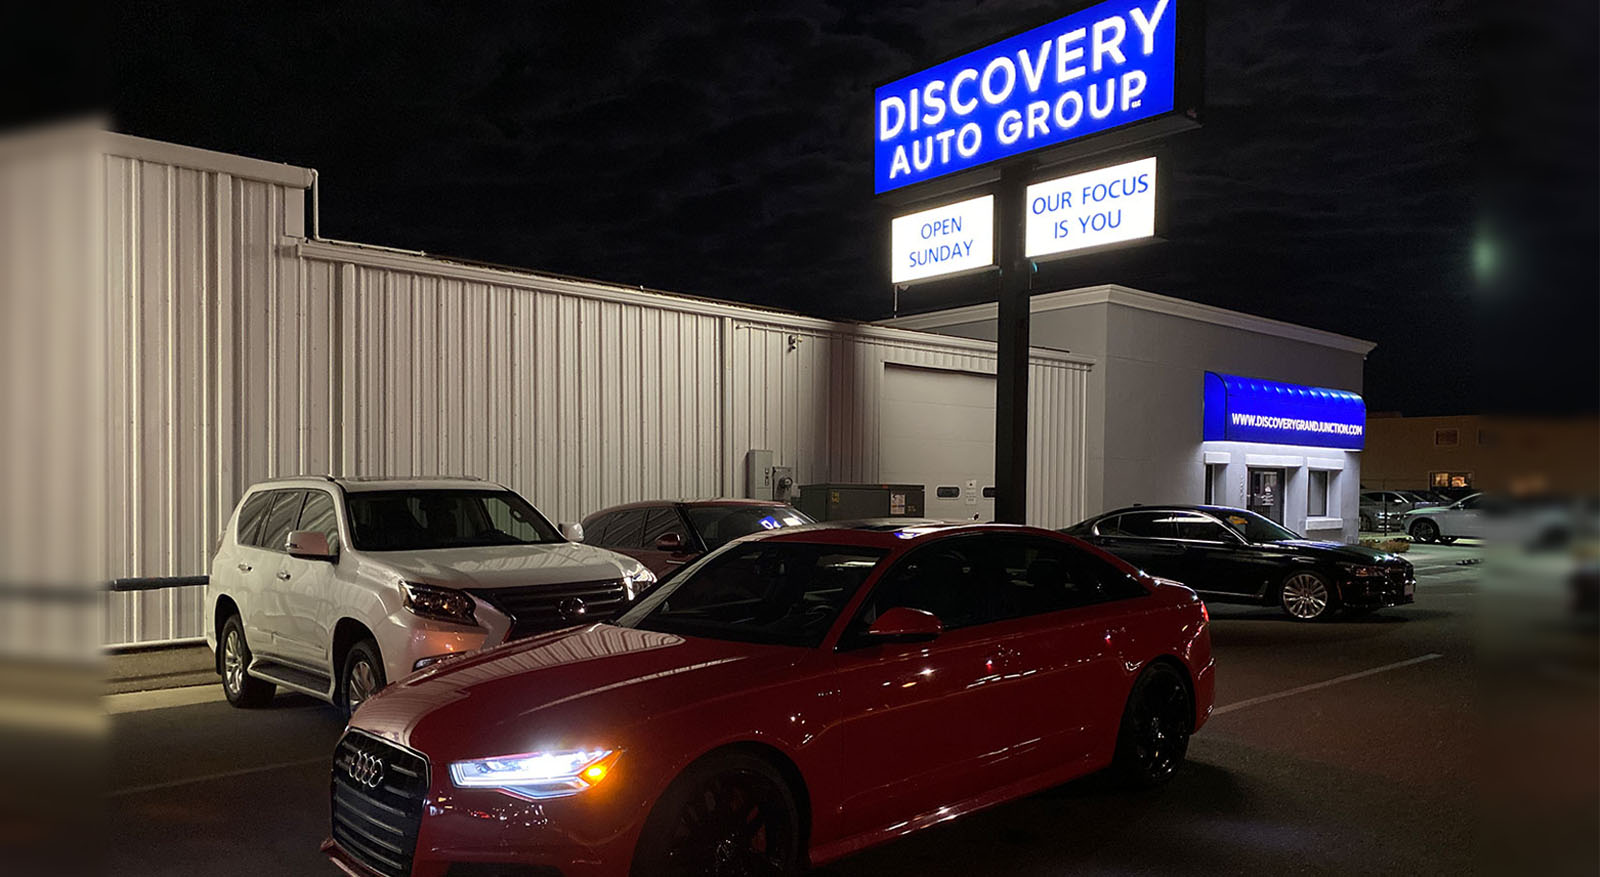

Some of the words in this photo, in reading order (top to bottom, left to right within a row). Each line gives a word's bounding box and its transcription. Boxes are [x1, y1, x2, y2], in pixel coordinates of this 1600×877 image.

[880, 0, 1169, 141] DISCOVERY
[889, 122, 982, 179] AUTO
[997, 70, 1147, 144] GROUP
[1032, 191, 1072, 215] OUR
[1082, 173, 1149, 205] FOCUS
[921, 216, 963, 240] OPEN
[1054, 219, 1069, 239] IS
[1079, 209, 1122, 234] YOU
[909, 239, 974, 268] SUNDAY
[1231, 412, 1363, 436] WWW.DISCOVERYGRANDJUNCTION.COM
